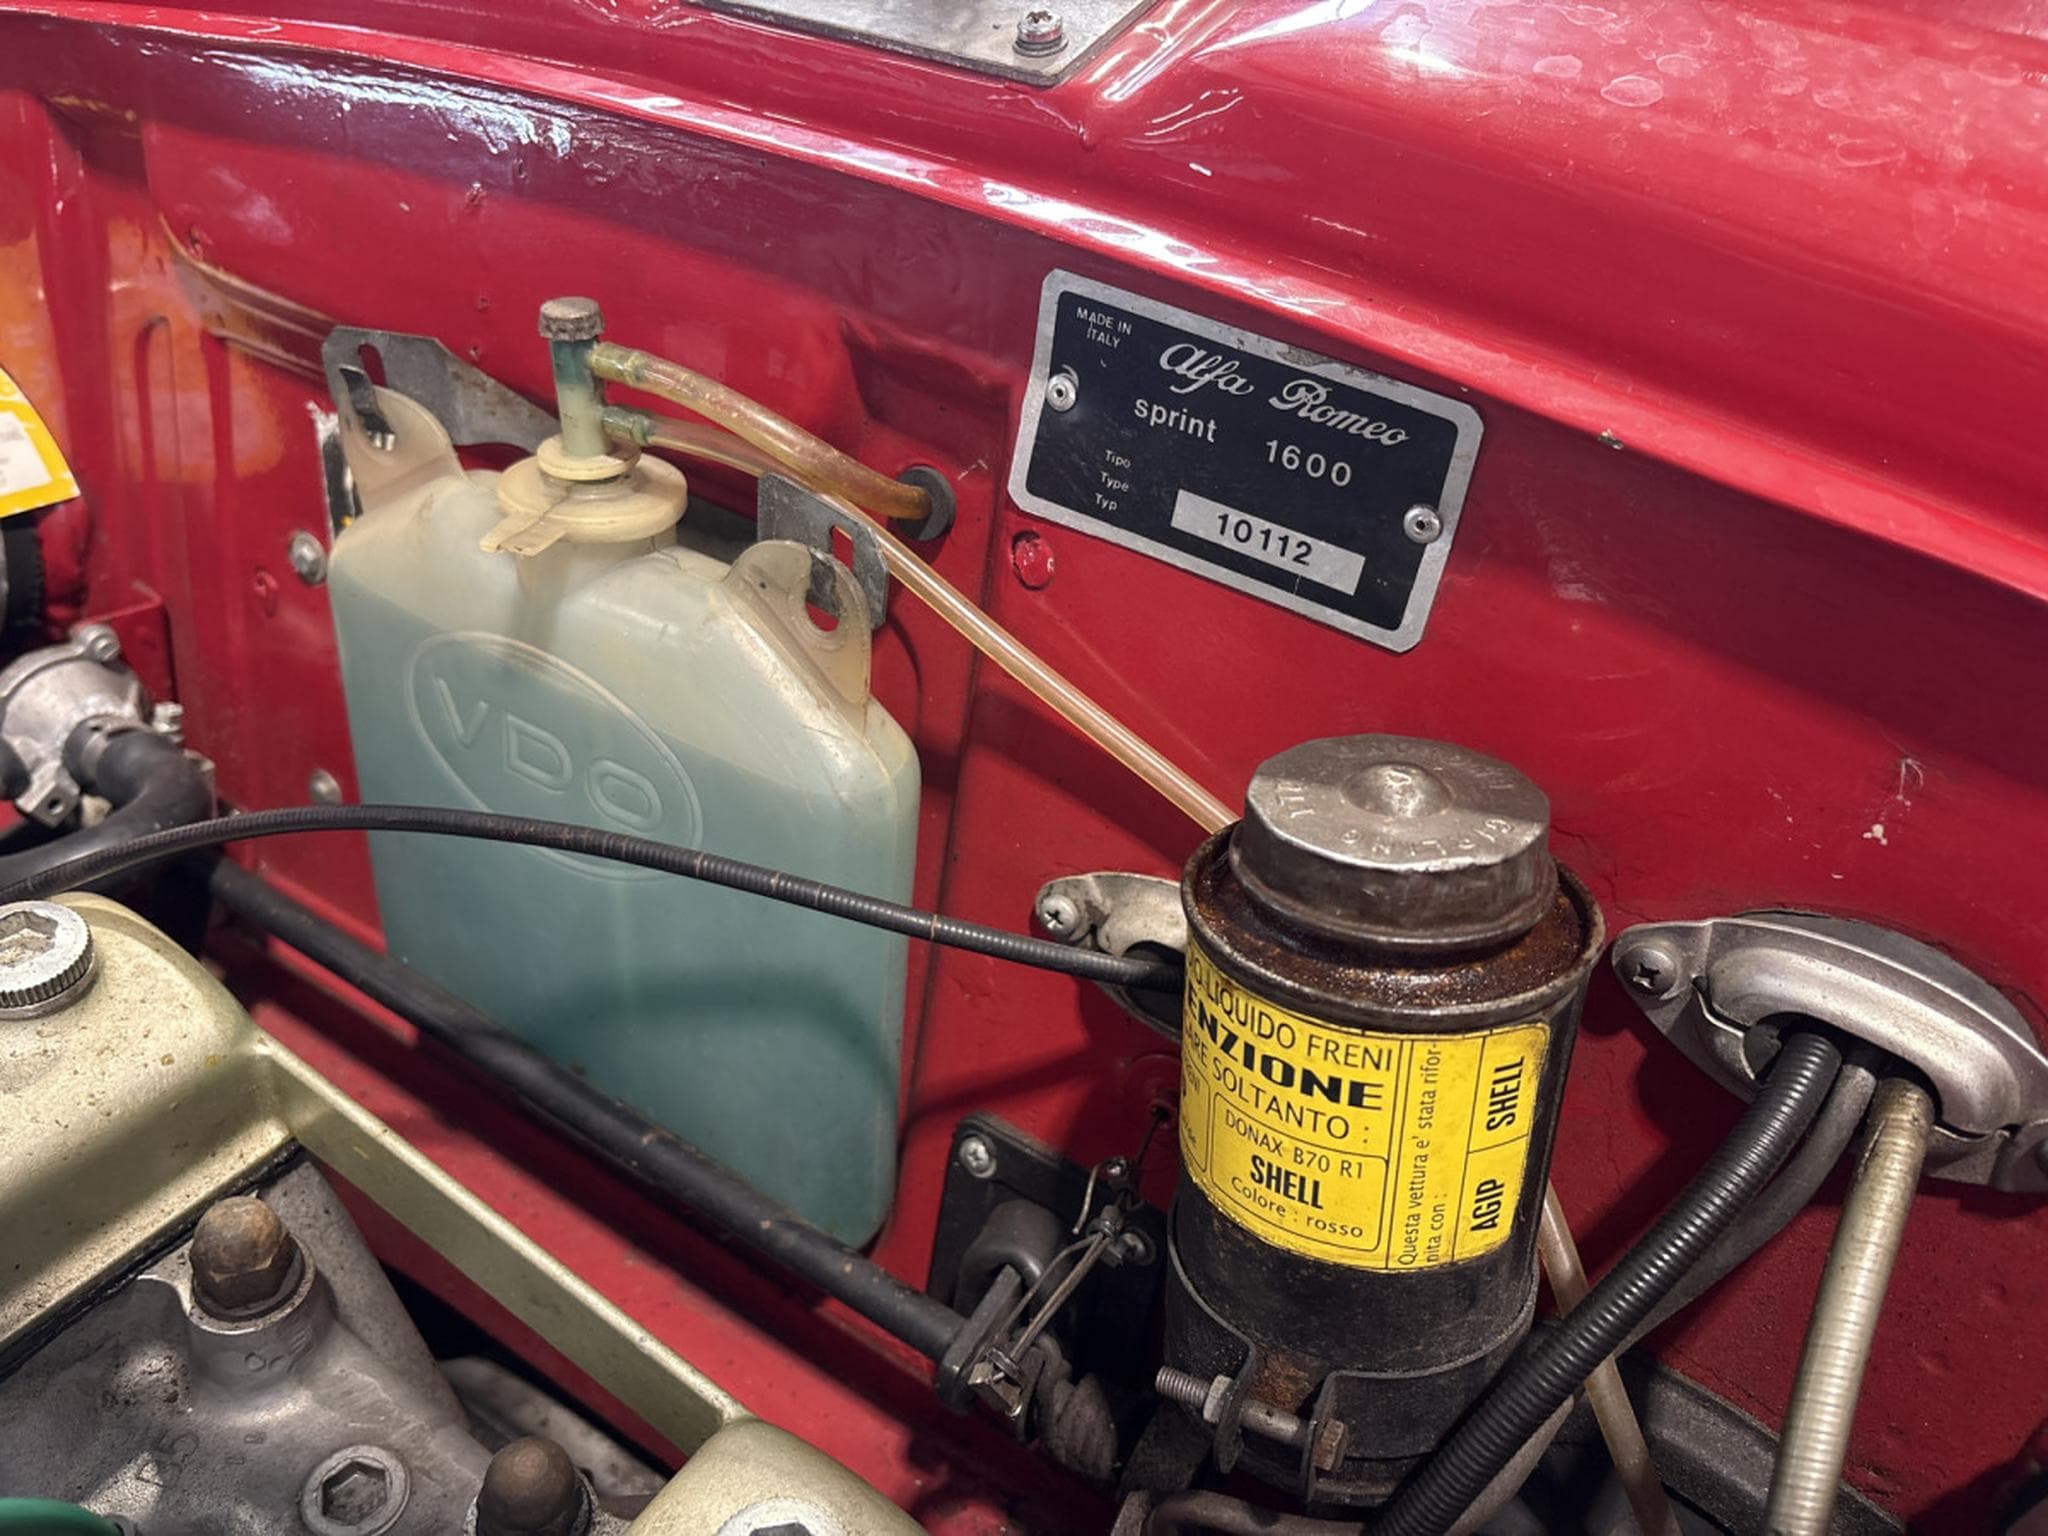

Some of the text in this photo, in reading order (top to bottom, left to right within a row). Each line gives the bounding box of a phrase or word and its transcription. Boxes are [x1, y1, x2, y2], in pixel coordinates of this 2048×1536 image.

[1076, 306, 1133, 336] MADE IN
[1086, 327, 1121, 349] ITALY
[1134, 398, 1218, 443] sprint
[1159, 343, 1410, 447] Alfa Romeo
[1100, 470, 1129, 493] Type
[1105, 449, 1131, 469] Tipo
[1266, 440, 1352, 487] 1600
[1095, 492, 1118, 511] Typ
[1217, 513, 1313, 567] 10112
[432, 672, 664, 833] VDO
[1188, 981, 1385, 1112] ENZIONE
[1306, 1033, 1393, 1072] FRENI
[1212, 1056, 1350, 1140] SOLTANTO
[1417, 1089, 1437, 1130] stata
[1486, 1056, 1526, 1132] SHELL
[1224, 1108, 1284, 1158] DONAX
[1293, 1146, 1331, 1173] B70
[1339, 1159, 1364, 1180] R1
[1231, 1176, 1287, 1218] Colore
[1306, 1215, 1364, 1239] rosso
[1250, 1154, 1324, 1211] SHELL
[1408, 1154, 1429, 1209] vettura
[1470, 1178, 1505, 1232] AGIP
[1397, 1212, 1421, 1266] Questa
[1430, 1203, 1446, 1232] con
[1423, 1234, 1442, 1263] nita
